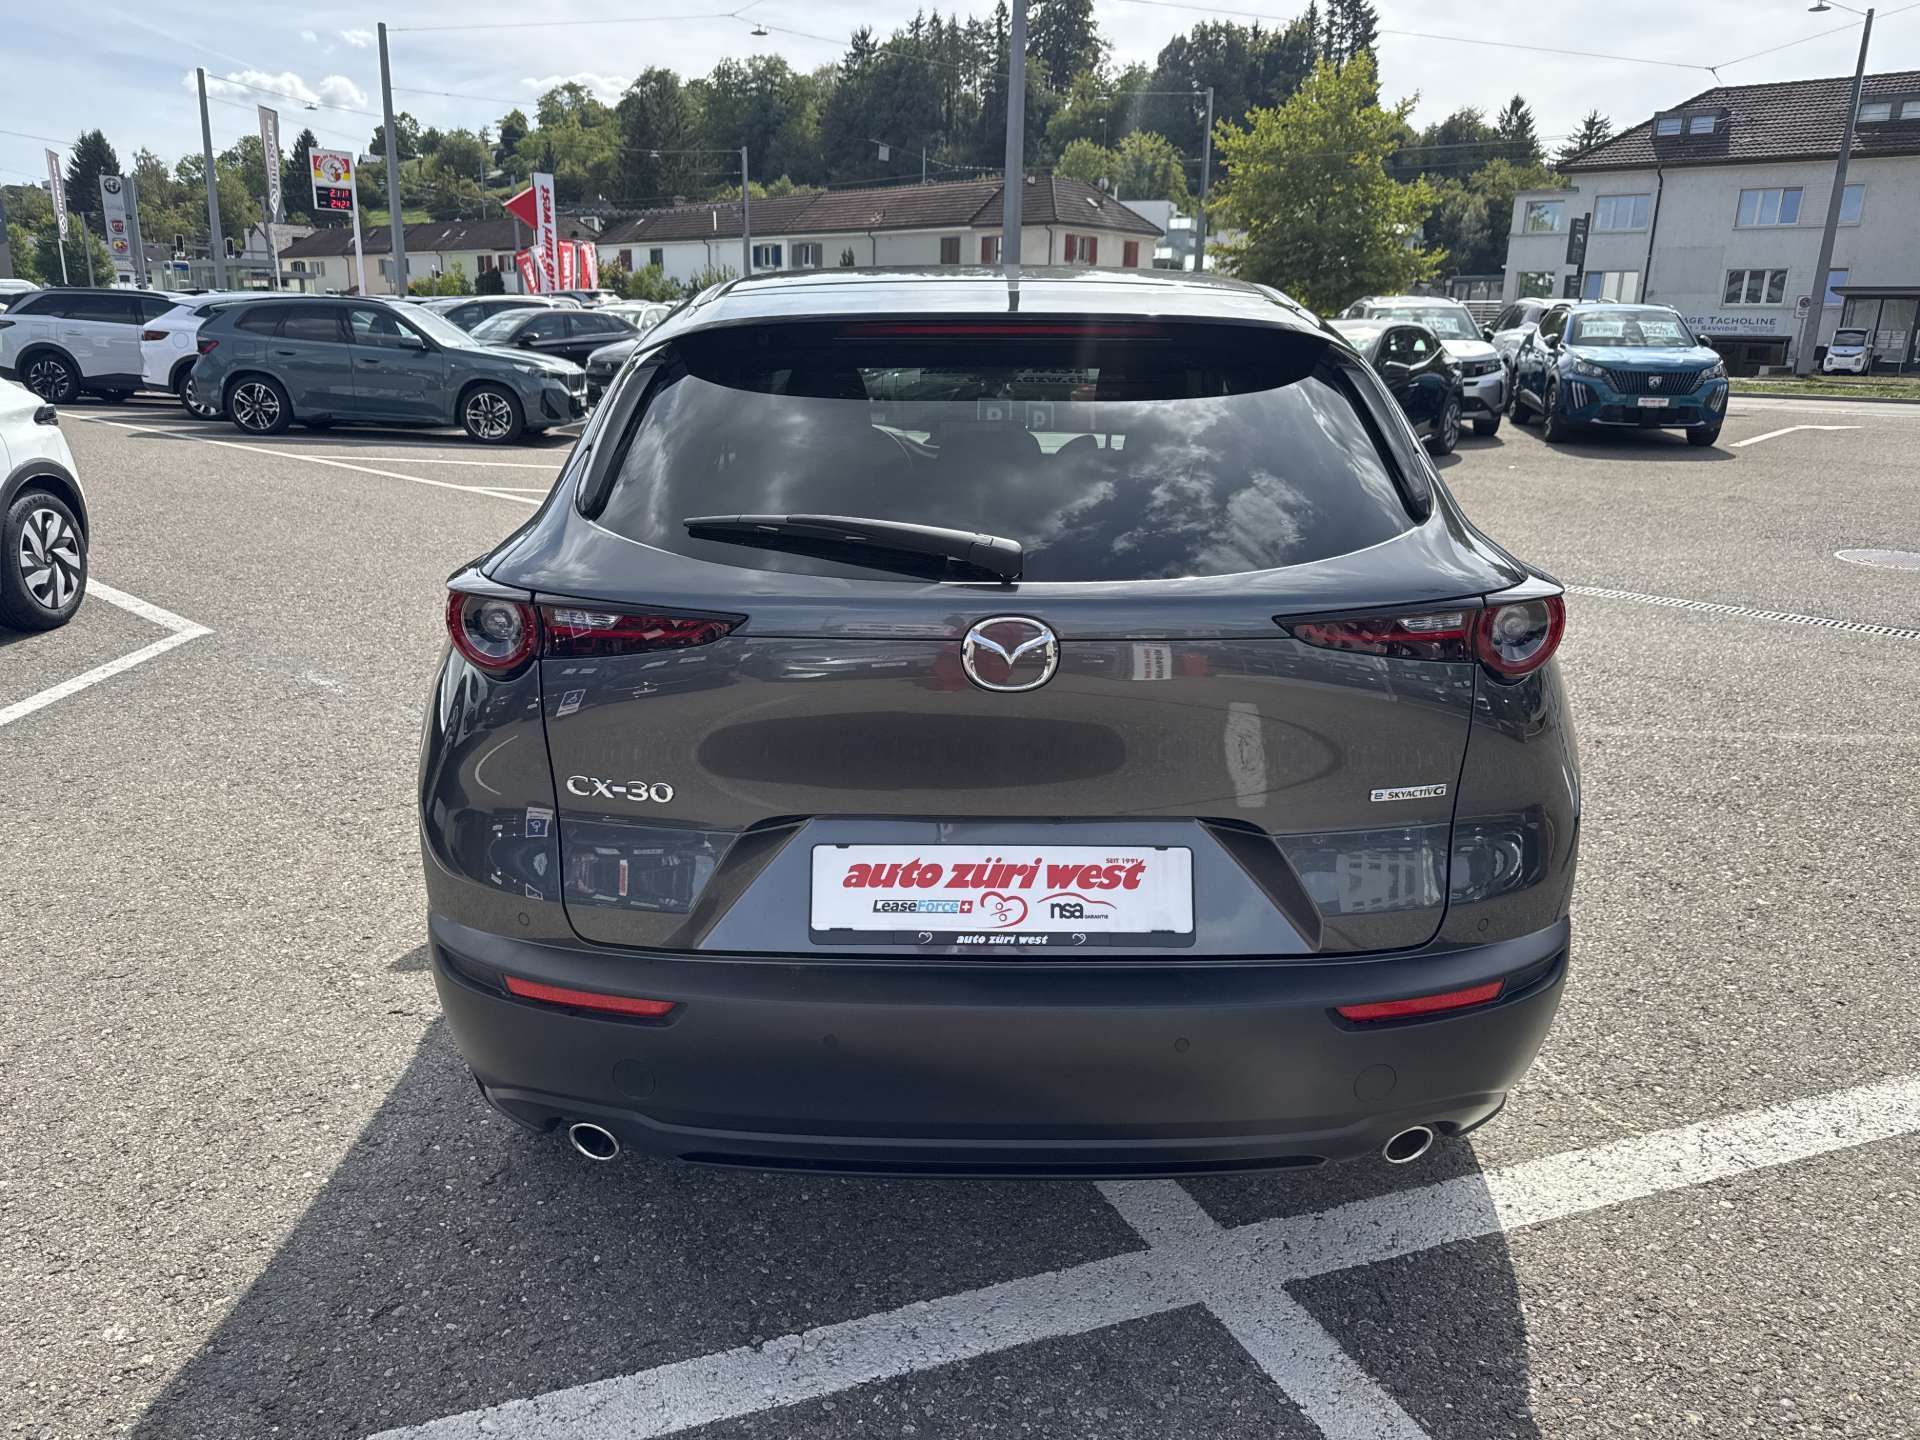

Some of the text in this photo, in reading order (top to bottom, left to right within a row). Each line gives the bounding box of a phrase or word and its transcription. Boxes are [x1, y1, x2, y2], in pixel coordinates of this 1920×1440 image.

[1709, 316, 1777, 326] TACHOLINE
[566, 775, 675, 803] CX-30
[842, 857, 1147, 890] auto züri west
[872, 899, 959, 914] LeaseForce
[1050, 902, 1083, 919] nsa
[956, 934, 1049, 946] auto züri west
